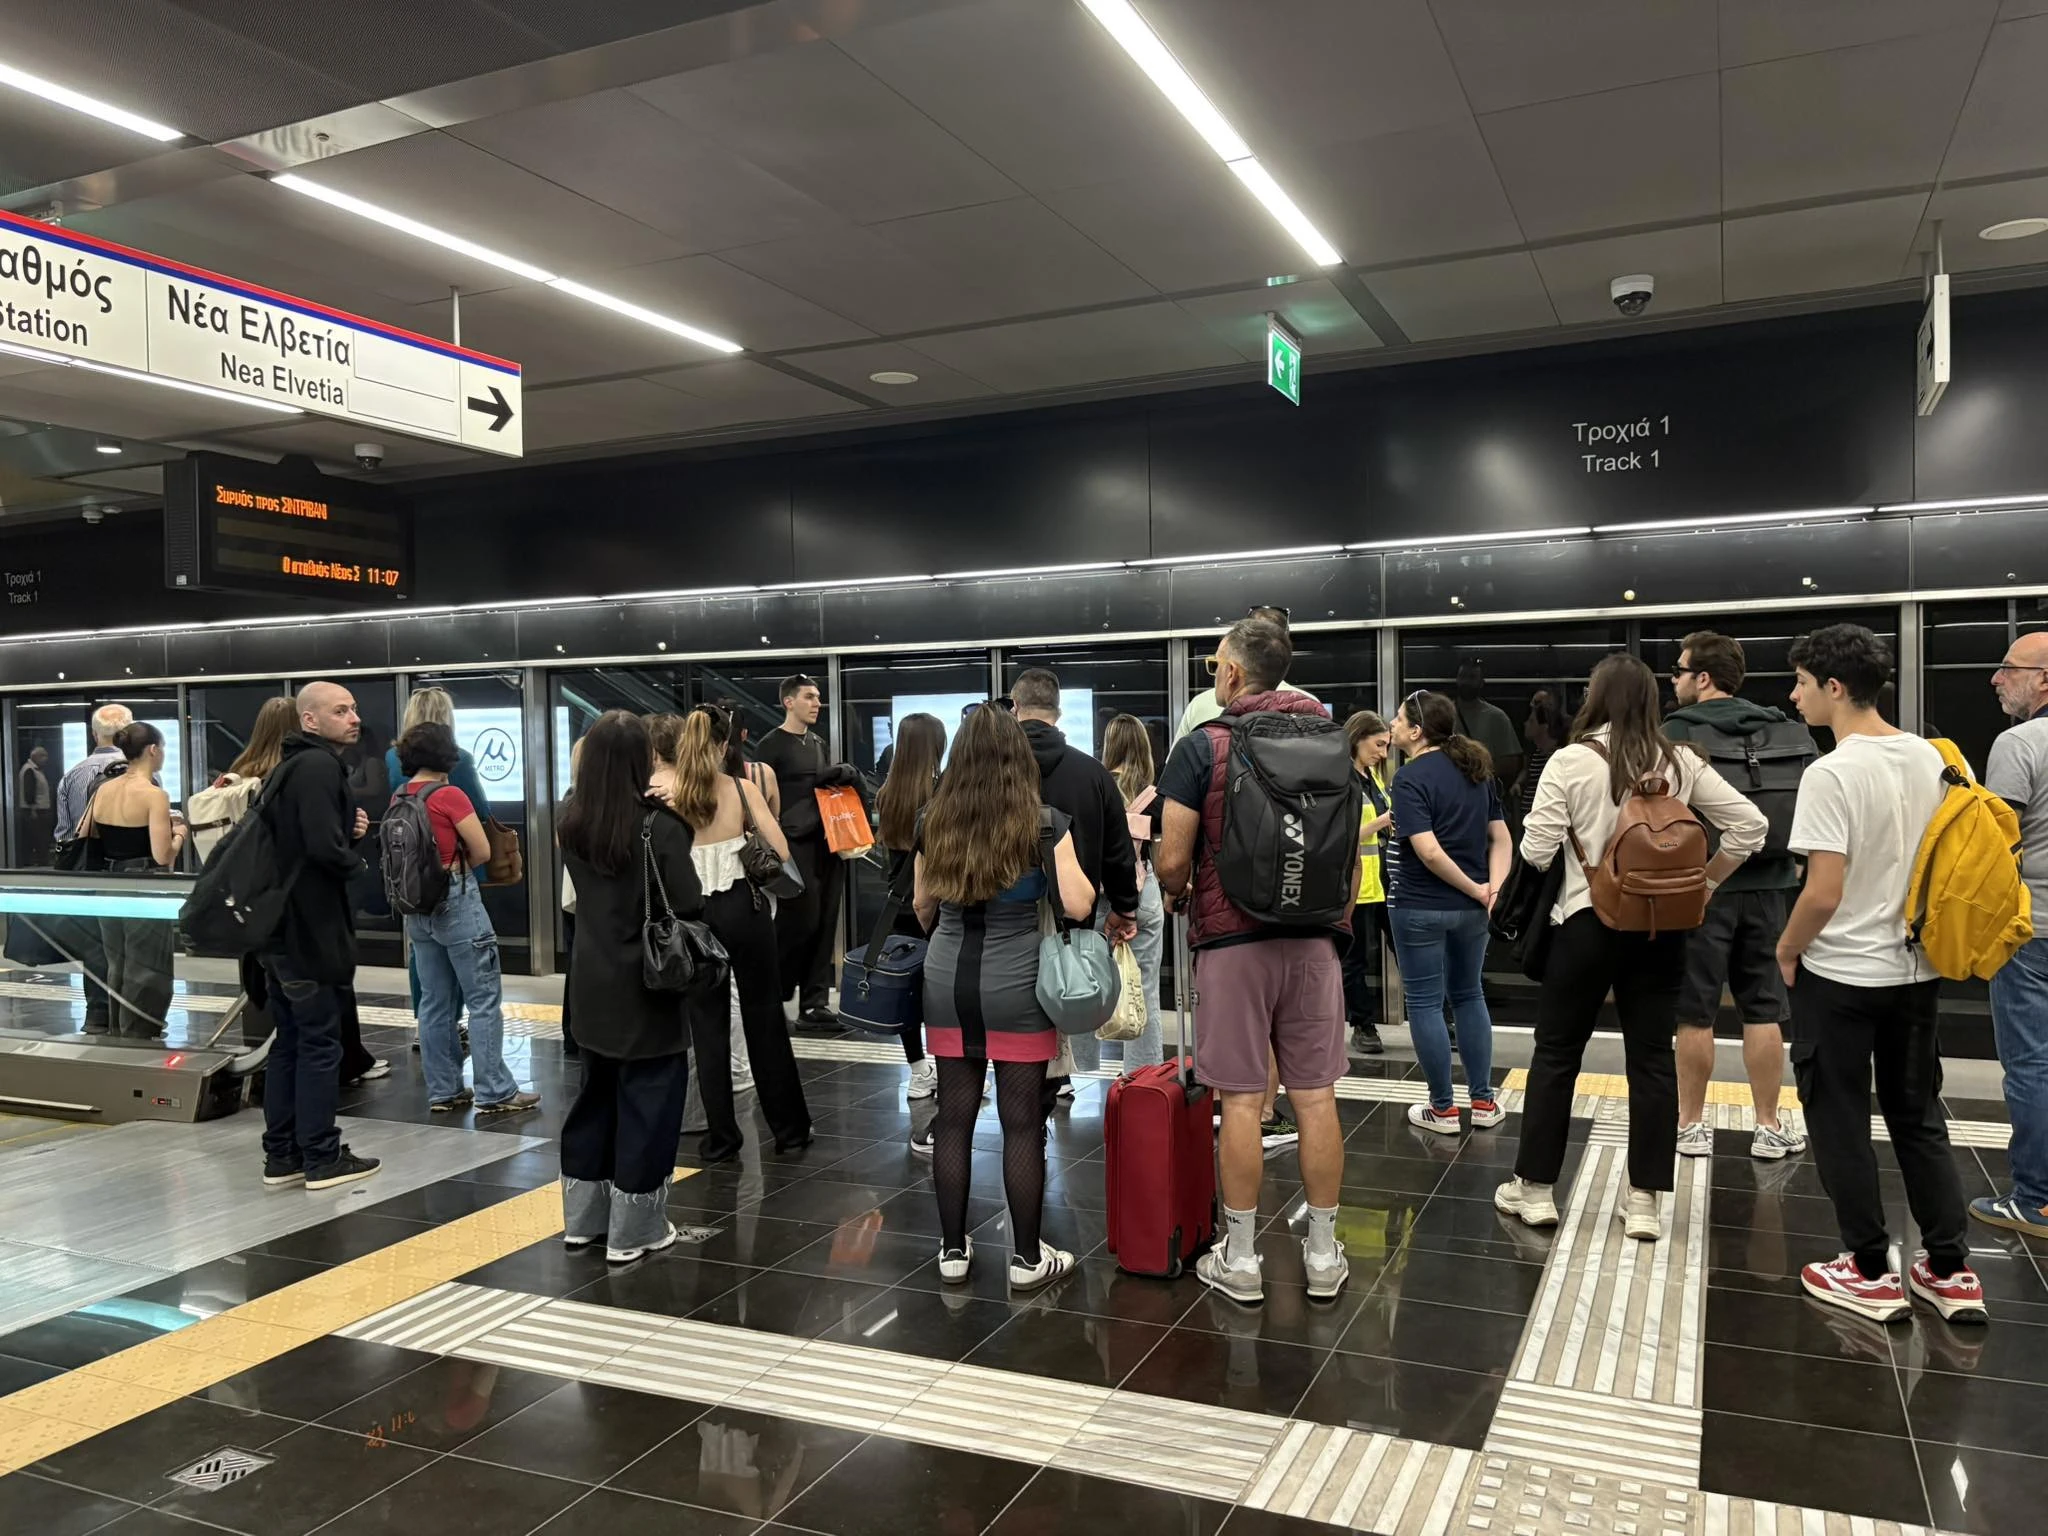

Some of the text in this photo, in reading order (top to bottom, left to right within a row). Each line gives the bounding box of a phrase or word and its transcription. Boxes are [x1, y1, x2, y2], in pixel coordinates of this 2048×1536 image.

[168, 284, 350, 366] Νέα Ελβετία
[221, 352, 344, 405] Nea Elvetia
[1571, 415, 1669, 446] Τροχιά 1
[1581, 449, 1659, 473] Track 1
[216, 485, 254, 508] Συρμός
[255, 496, 280, 512] προς
[367, 567, 399, 586] 11:07
[8, 591, 31, 604] Track
[1280, 849, 1304, 908] YONEX
